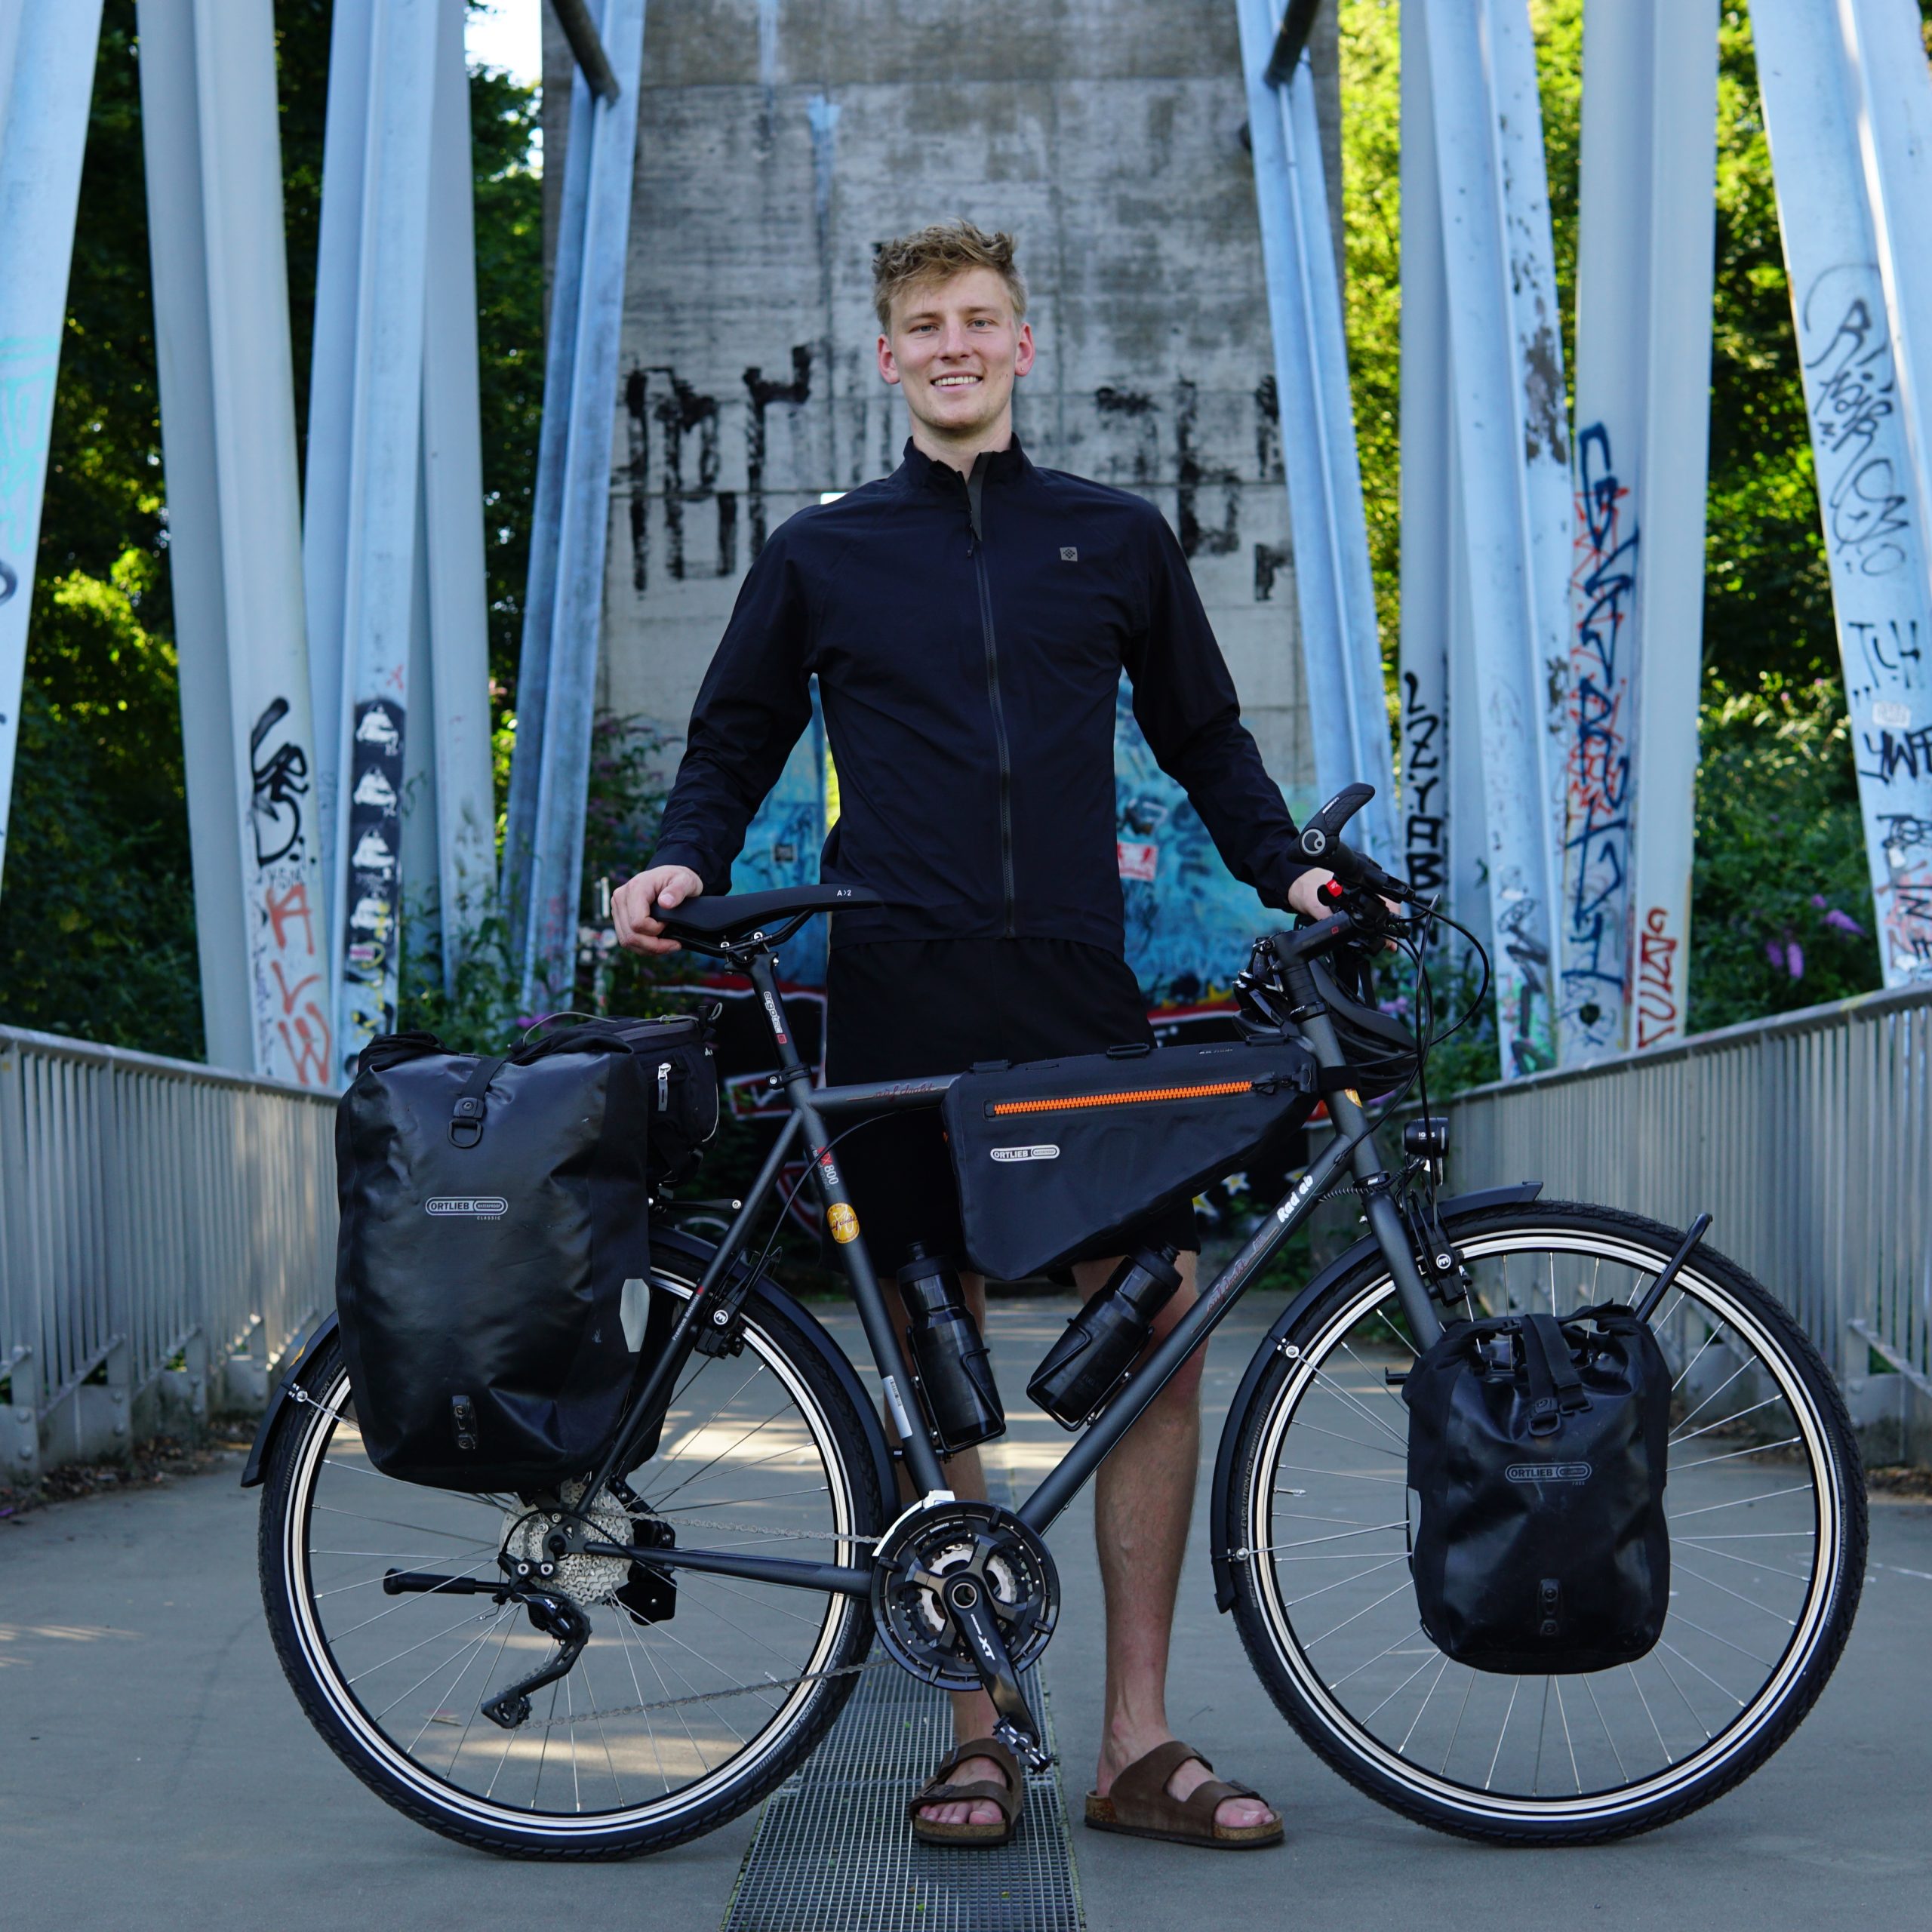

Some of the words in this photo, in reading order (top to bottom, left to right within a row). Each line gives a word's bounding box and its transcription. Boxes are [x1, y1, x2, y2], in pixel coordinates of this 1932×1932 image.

[764, 991, 783, 1034] ergotec
[994, 1150, 1029, 1159] ORTLIEB
[823, 1164, 839, 1185] 800
[430, 1202, 469, 1211] ORTLIEB
[1276, 1191, 1300, 1223] Rad
[1299, 1174, 1314, 1195] ab
[1511, 1468, 1554, 1478] ORTLIEB
[1241, 1477, 1251, 1527] EVOLUTION
[978, 1635, 995, 1660] XT
[800, 1678, 828, 1724] EVOLUTION
[789, 1722, 801, 1736] DD
